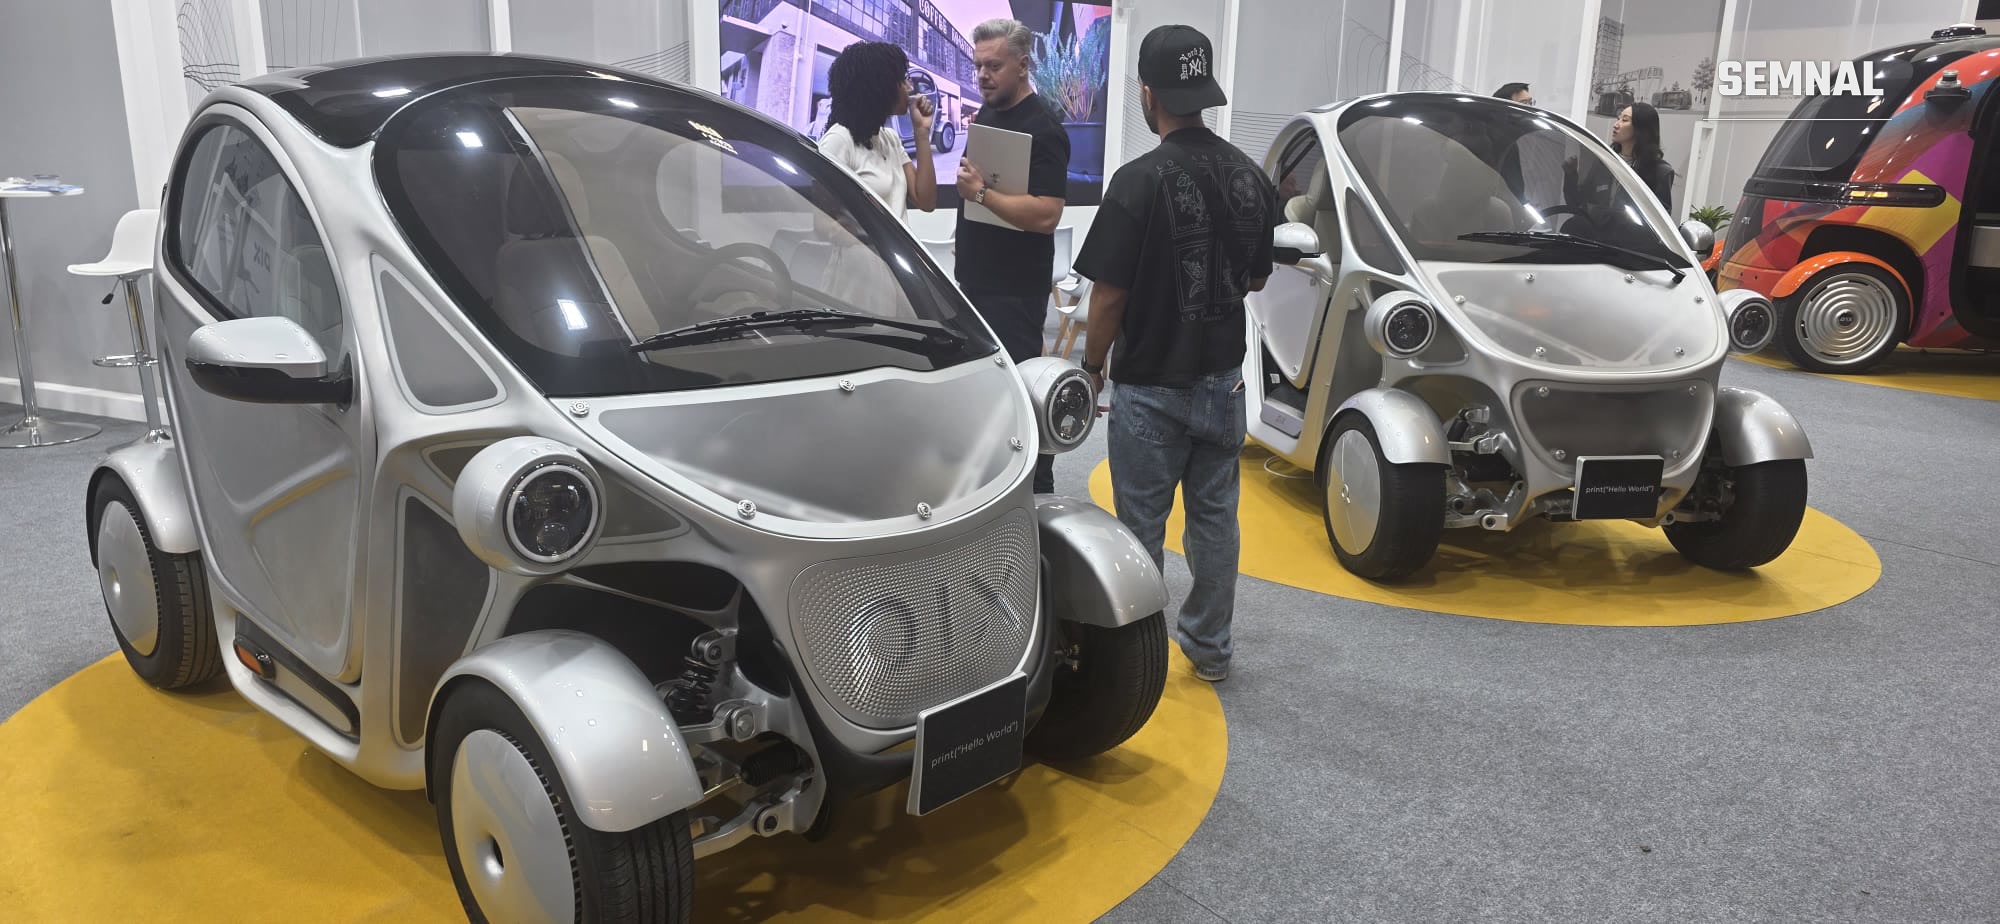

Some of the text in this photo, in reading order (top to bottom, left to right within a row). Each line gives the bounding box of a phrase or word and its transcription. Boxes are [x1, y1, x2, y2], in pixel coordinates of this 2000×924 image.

[1585, 484, 1655, 495] print("Hello World")
[931, 720, 1019, 769] print("Hello World")
